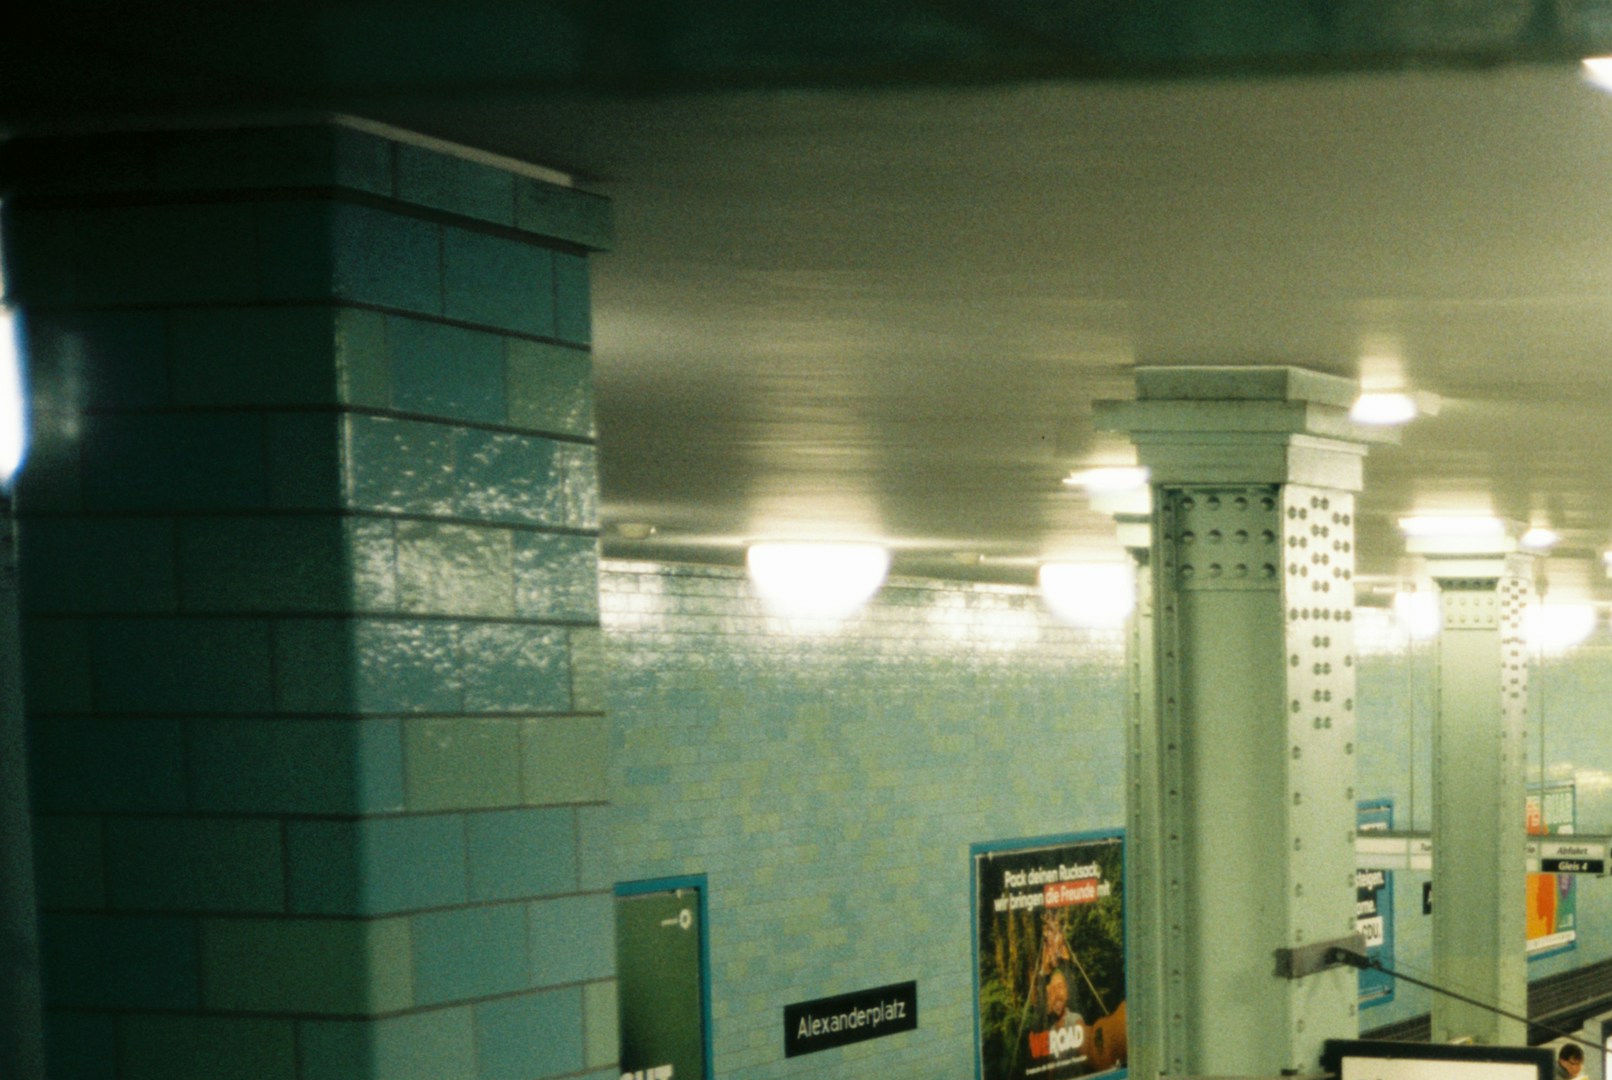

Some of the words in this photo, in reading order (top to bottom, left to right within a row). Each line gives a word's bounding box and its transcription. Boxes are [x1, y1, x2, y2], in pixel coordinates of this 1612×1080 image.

[1004, 868, 1026, 888] Pack
[1027, 866, 1058, 885] deinen
[1558, 860, 1580, 872] Gleis
[1581, 861, 1589, 872] 4
[994, 893, 1008, 912] wir
[1009, 890, 1044, 911] bringen
[1045, 887, 1059, 905] die
[1060, 882, 1096, 902] Freunde
[1097, 879, 1110, 896] mit
[797, 999, 907, 1040] Alexanderplatz
